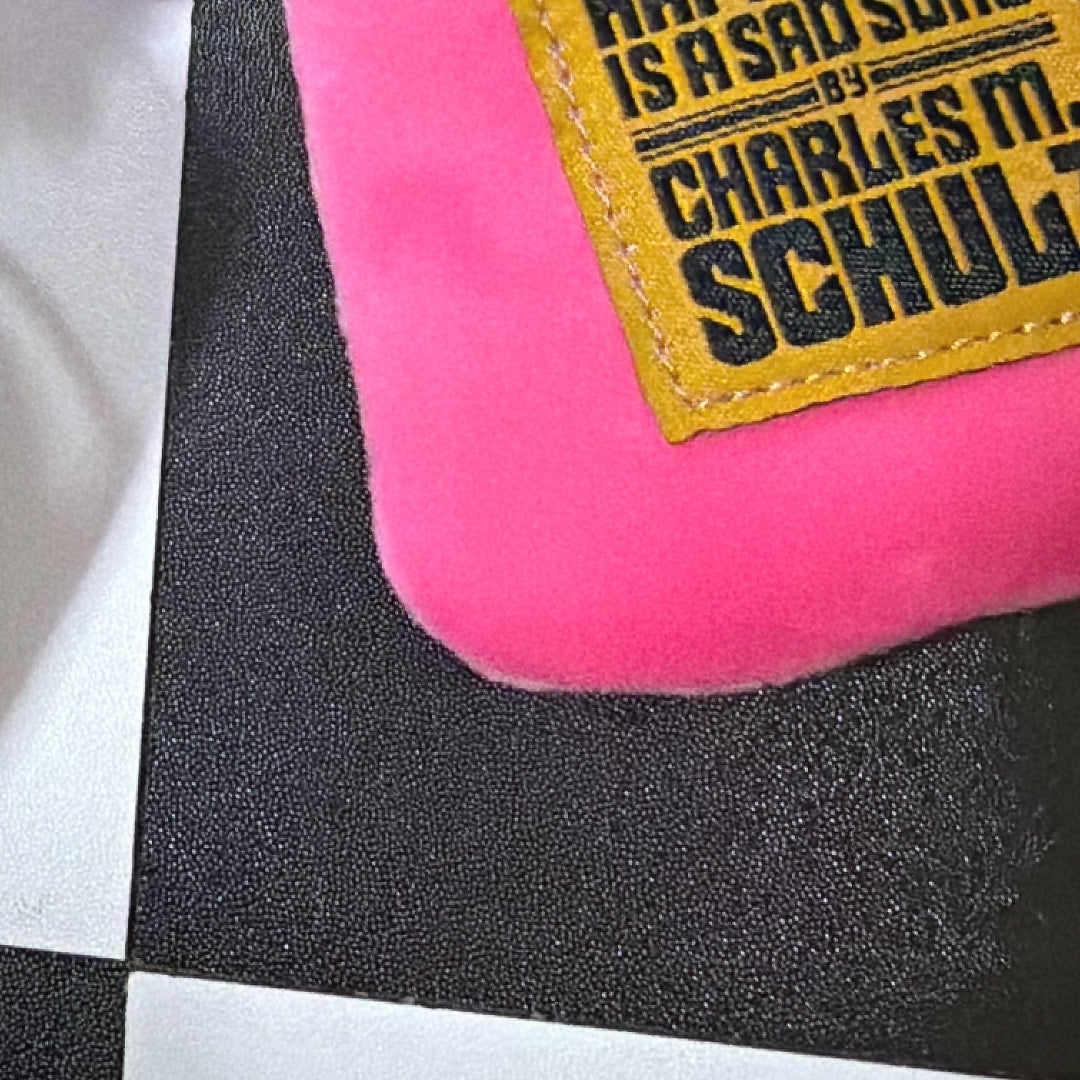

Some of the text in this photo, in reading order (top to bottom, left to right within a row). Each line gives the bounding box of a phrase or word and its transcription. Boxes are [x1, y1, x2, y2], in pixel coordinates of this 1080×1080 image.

[604, 42, 676, 118] IS
[676, 30, 730, 98] A
[820, 65, 868, 105] BY
[650, 85, 979, 240] CHARLES
[681, 140, 1080, 366] SCHUL
